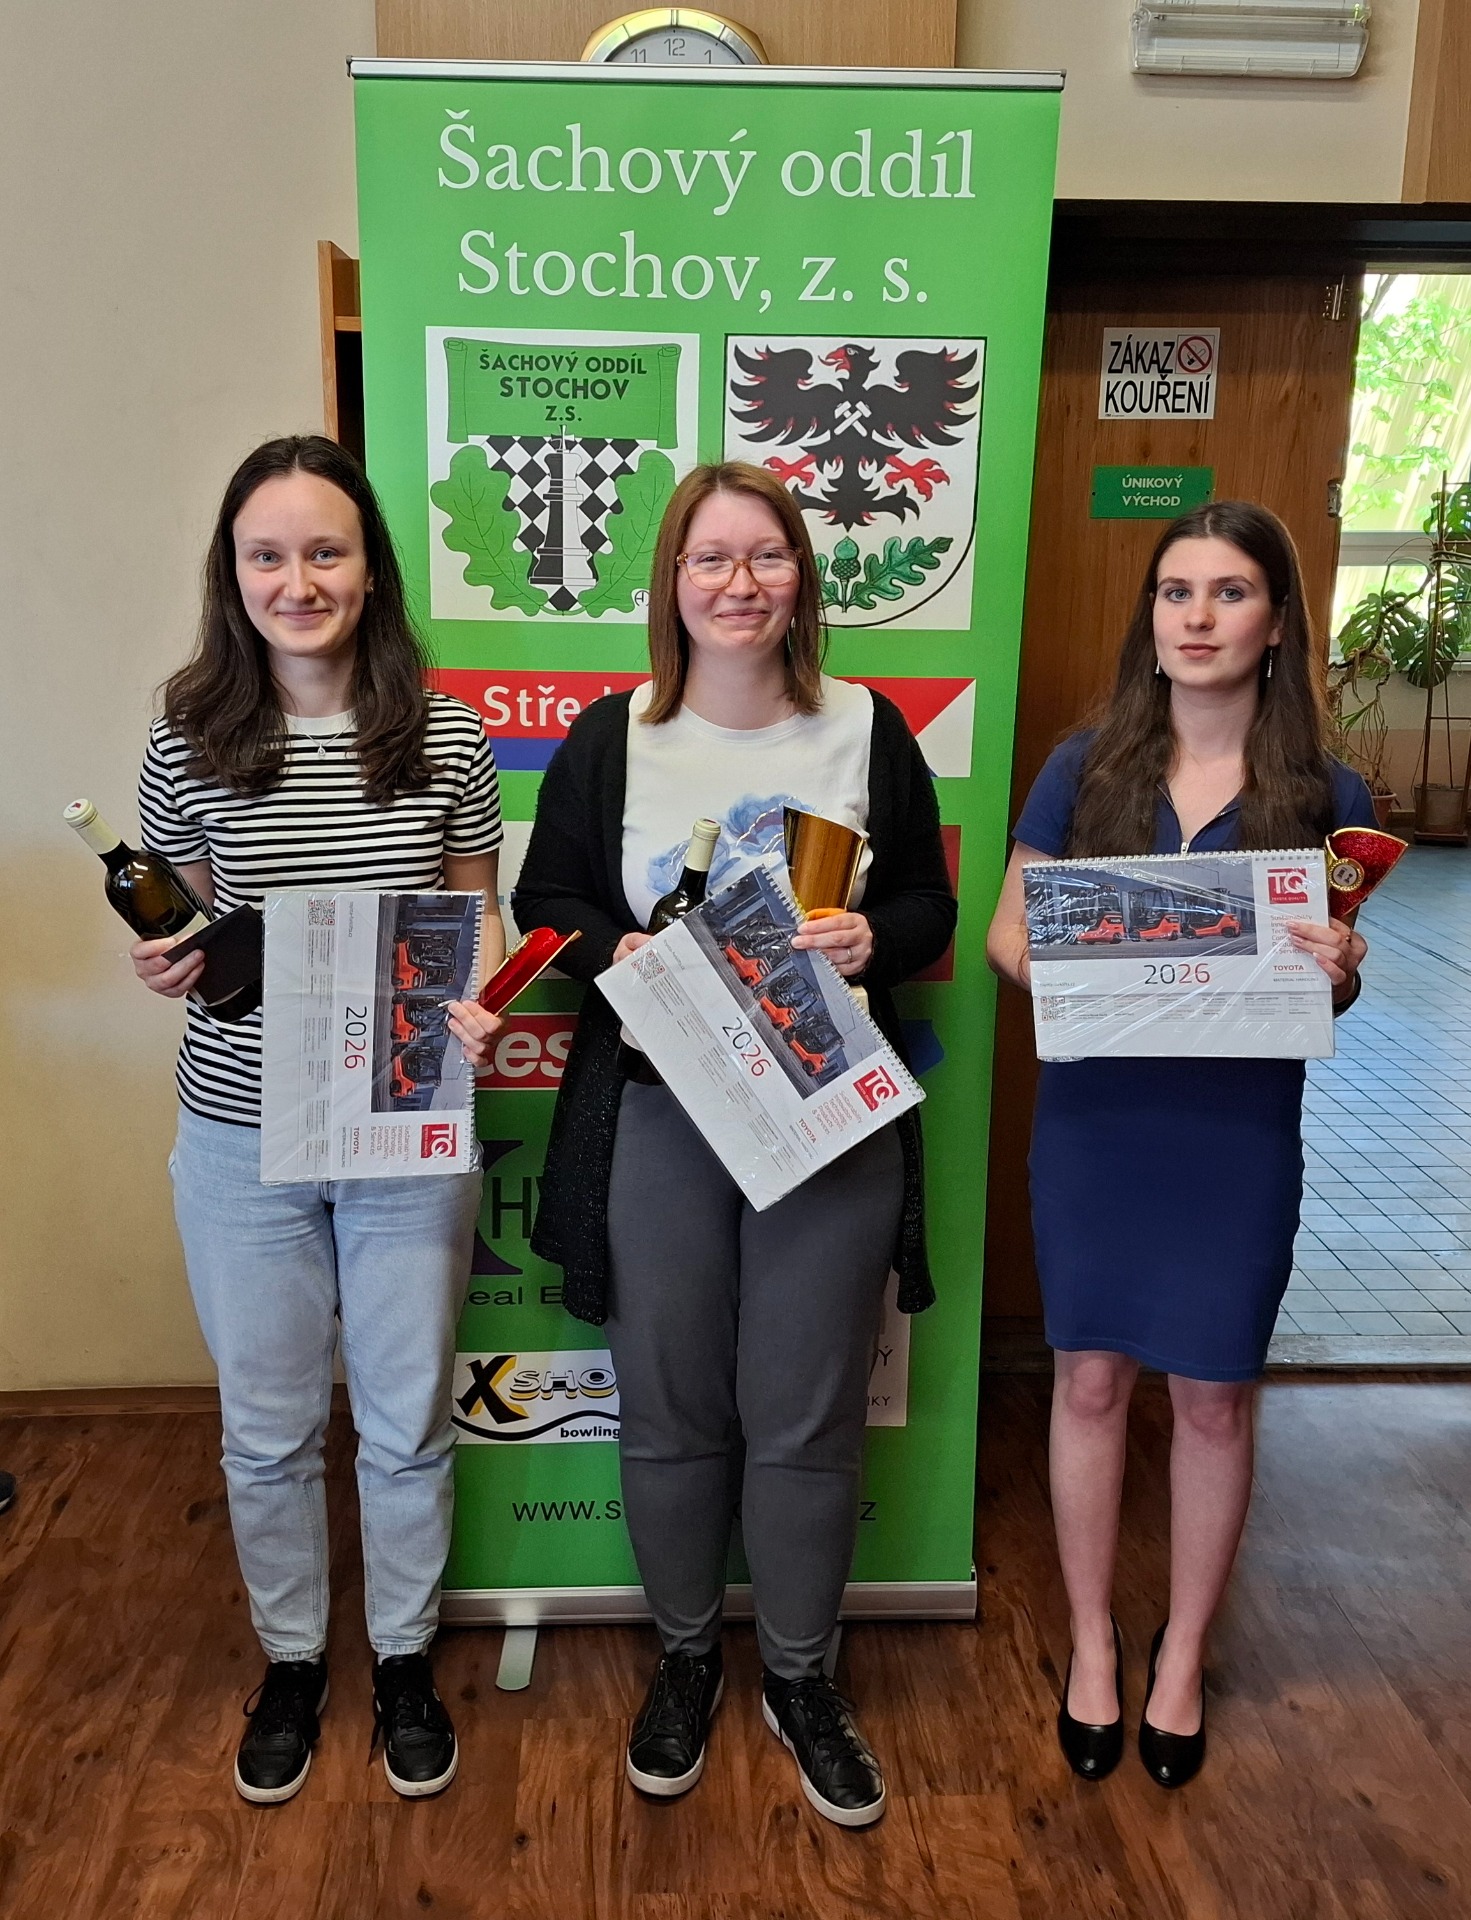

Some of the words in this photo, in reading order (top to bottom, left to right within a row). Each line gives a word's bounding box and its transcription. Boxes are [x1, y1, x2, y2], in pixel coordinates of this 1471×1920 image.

[664, 38, 685, 57] 12
[436, 107, 757, 216] Šachový
[780, 128, 976, 199] oddíl
[458, 229, 772, 313] Stochov,
[798, 256, 854, 302] z.
[882, 256, 928, 304] s.
[479, 349, 579, 373] ŠACHOVÝ
[585, 353, 648, 375] ODDÍL
[1107, 334, 1175, 374] ZÁKAZ
[499, 376, 630, 401] STOCHOV
[1104, 374, 1211, 414] KOUŘENÍ
[545, 405, 582, 422] Z.S.
[1122, 474, 1183, 489] ÚNIKOVÝ
[1122, 492, 1181, 506] VÝCHOD
[483, 684, 611, 727] Stře
[1143, 962, 1211, 985] 2026
[344, 1005, 368, 1069] 2026
[721, 1016, 772, 1077] 2026
[475, 1031, 574, 1078] es
[864, 1066, 895, 1104] TQ
[431, 1123, 454, 1158] TQ
[798, 1117, 818, 1144] TOYOTA
[466, 1286, 523, 1306] eal
[511, 1499, 622, 1522] www.s
